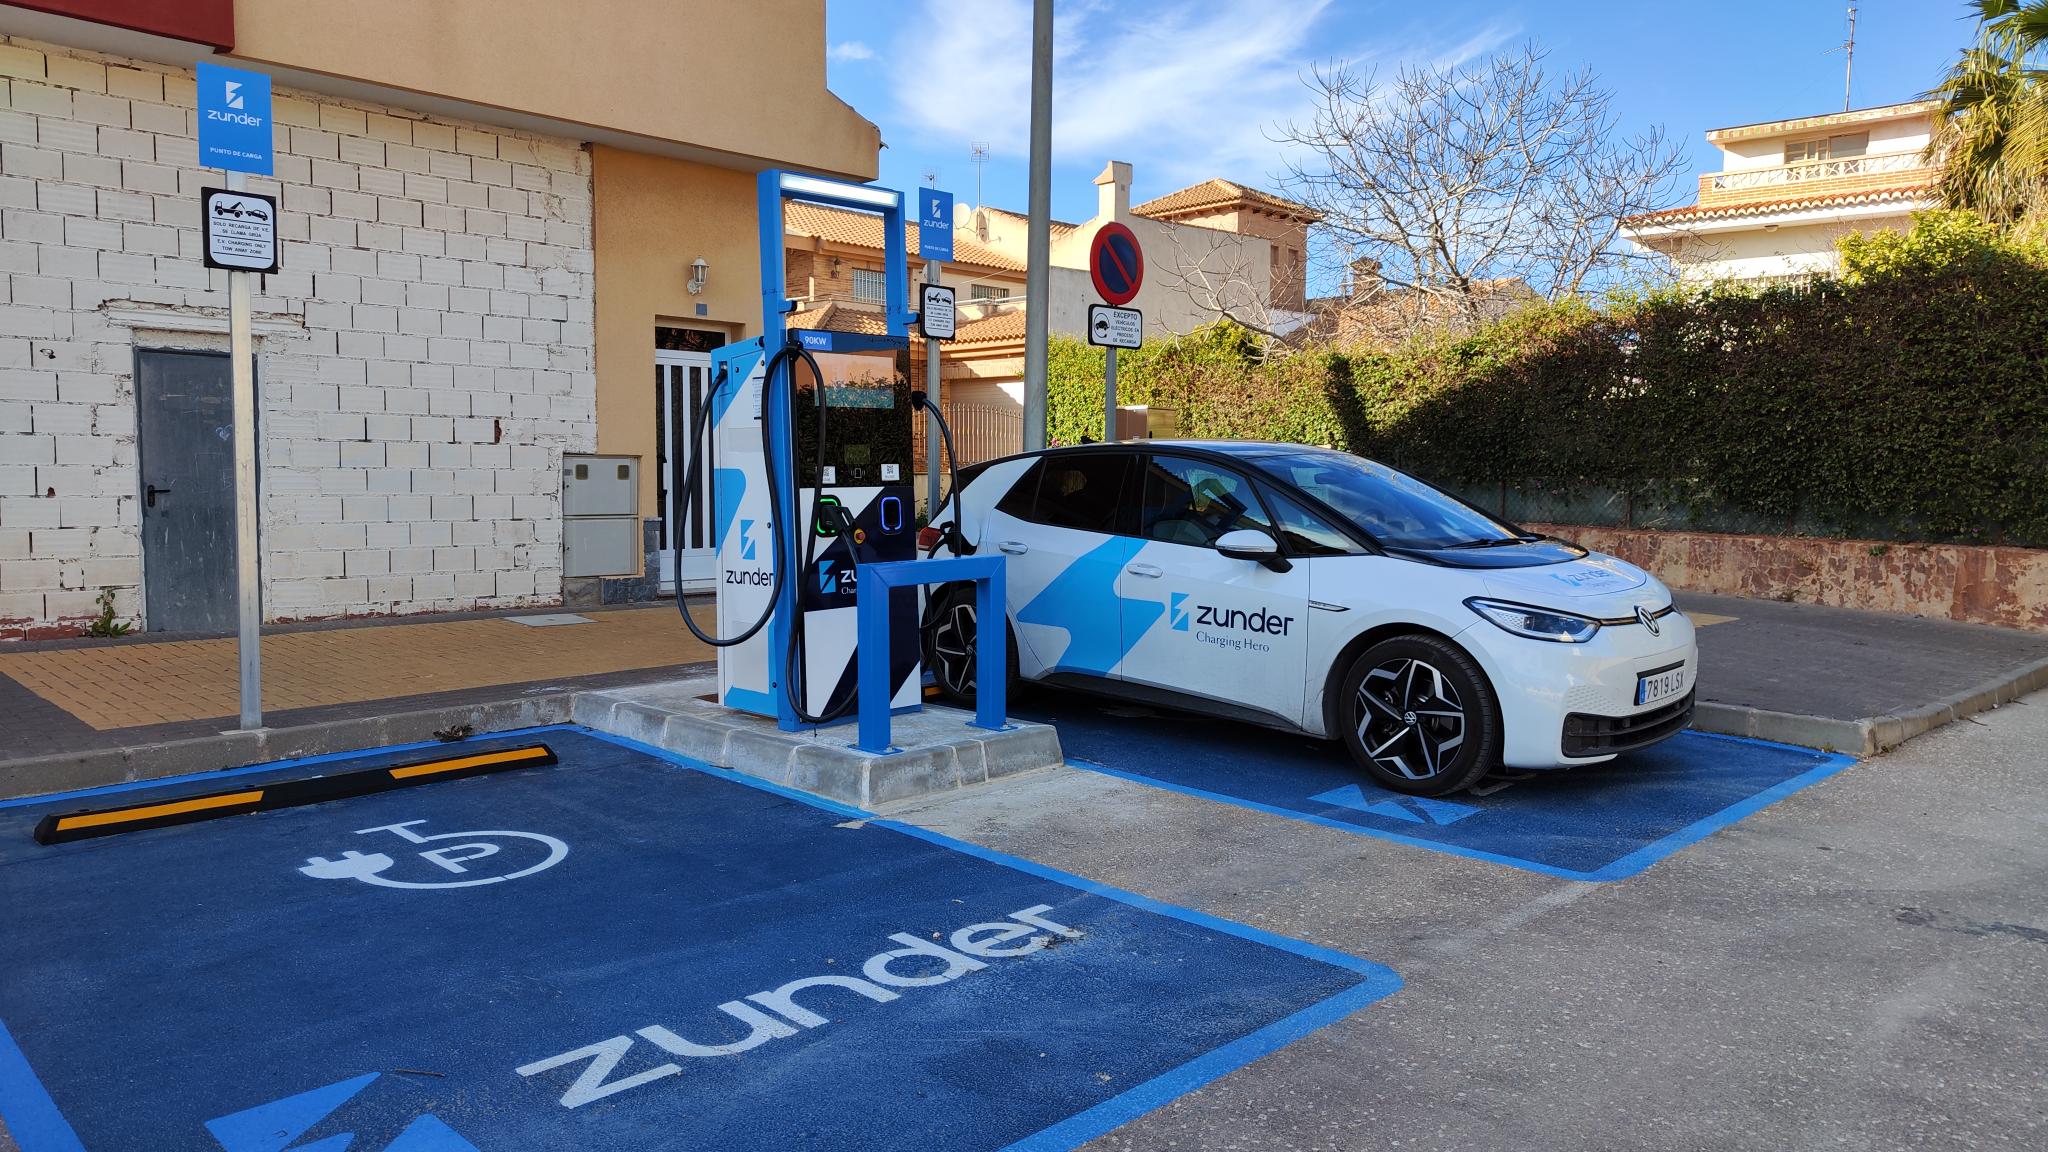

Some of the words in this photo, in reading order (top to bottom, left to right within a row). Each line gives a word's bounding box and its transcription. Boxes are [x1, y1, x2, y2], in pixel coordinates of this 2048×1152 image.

[207, 109, 263, 127] zunder
[210, 147, 232, 155] PUNTO
[241, 152, 263, 160] CARGA
[923, 219, 950, 230] zunder
[1113, 311, 1137, 320] EXCEPTO
[804, 335, 827, 346] 90KW
[725, 566, 774, 587] zunder
[1196, 604, 1295, 637] zunder
[1196, 631, 1242, 651] Charging
[1243, 638, 1271, 653] Hero
[1647, 676, 1669, 699] 7819
[1670, 670, 1684, 691] LSX
[514, 904, 1086, 1110] zunder
